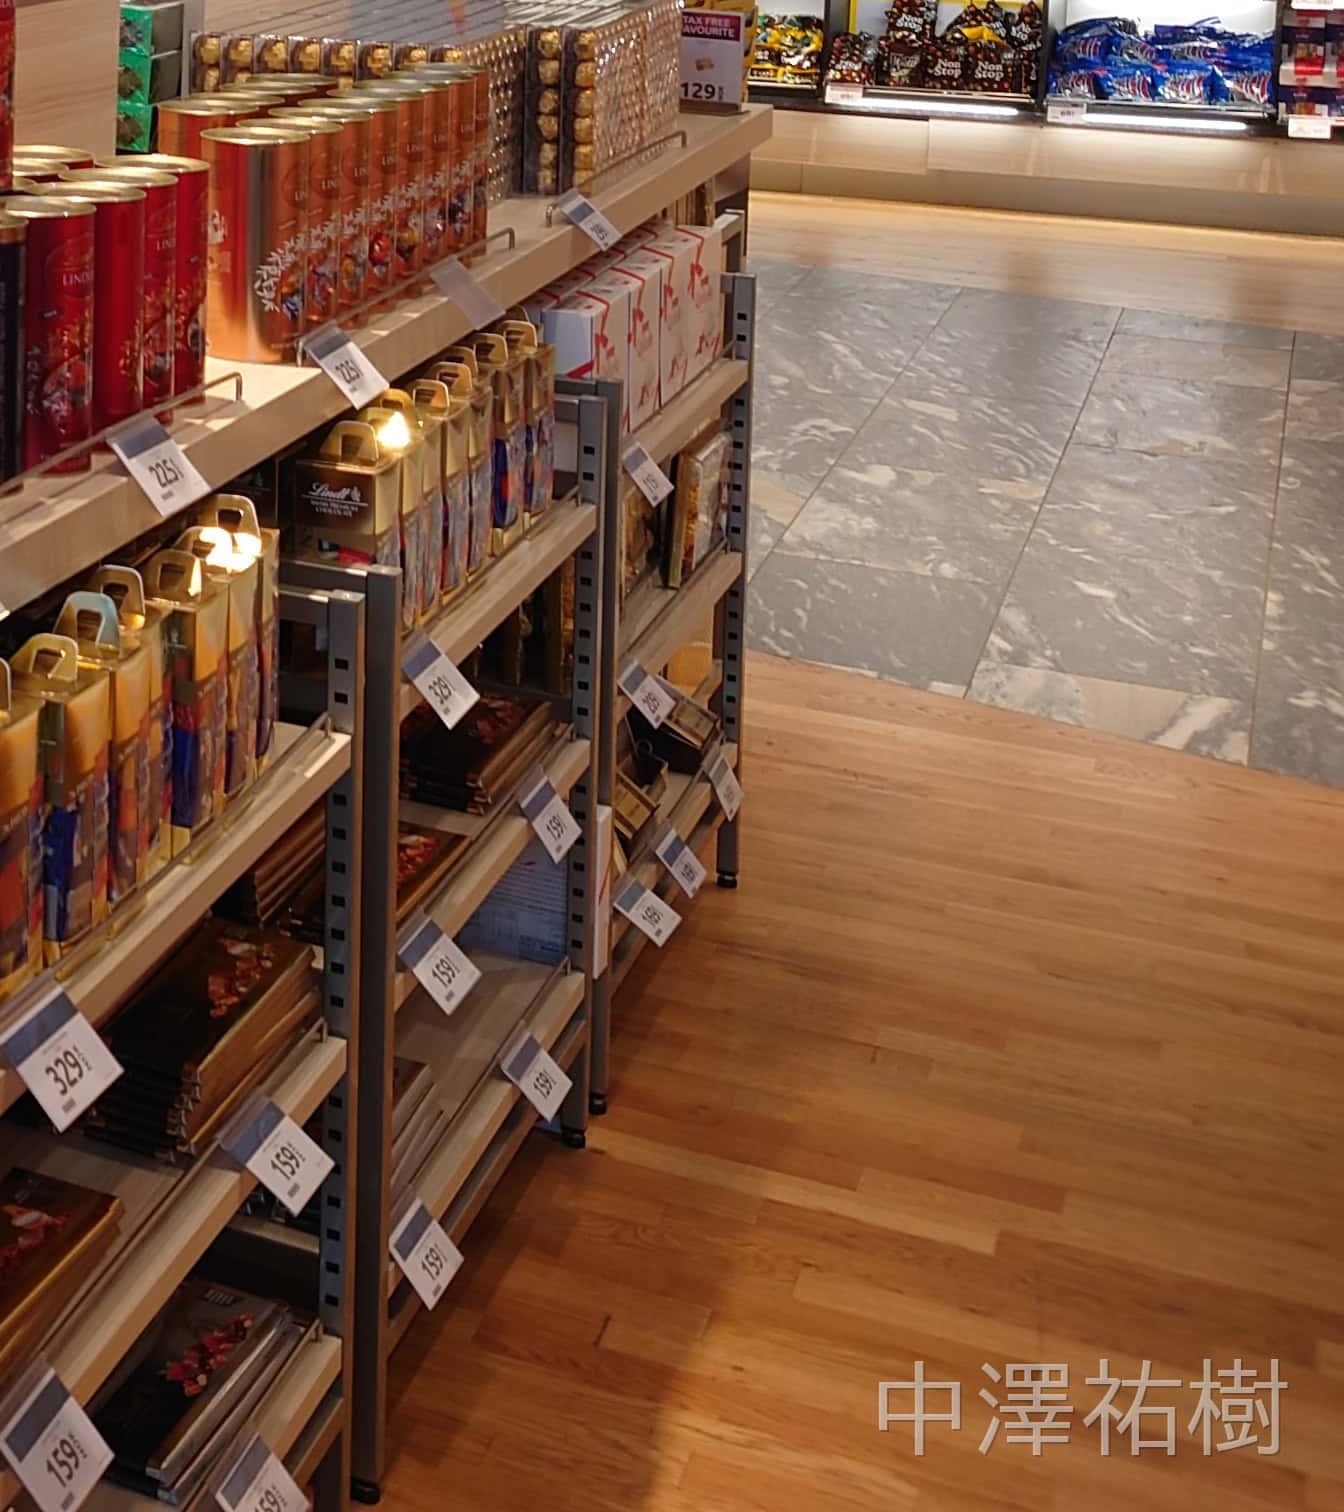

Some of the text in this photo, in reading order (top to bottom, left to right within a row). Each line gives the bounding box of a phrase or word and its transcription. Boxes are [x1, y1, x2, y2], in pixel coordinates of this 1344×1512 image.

[683, 16, 731, 28] TAX FREE
[934, 67, 961, 77] Stop
[938, 59, 960, 69] Non
[975, 70, 1004, 81] Stop
[978, 61, 1003, 71] Non
[681, 82, 715, 99] 129
[334, 360, 359, 385] 225
[148, 457, 178, 488] 225
[308, 482, 350, 499] Lindt
[545, 815, 561, 842] 159
[431, 955, 454, 989] 159
[44, 1049, 82, 1098] 329
[533, 1071, 552, 1098] 159
[268, 1145, 301, 1181] 159
[420, 1246, 442, 1281] 159
[44, 1438, 81, 1491] 159
